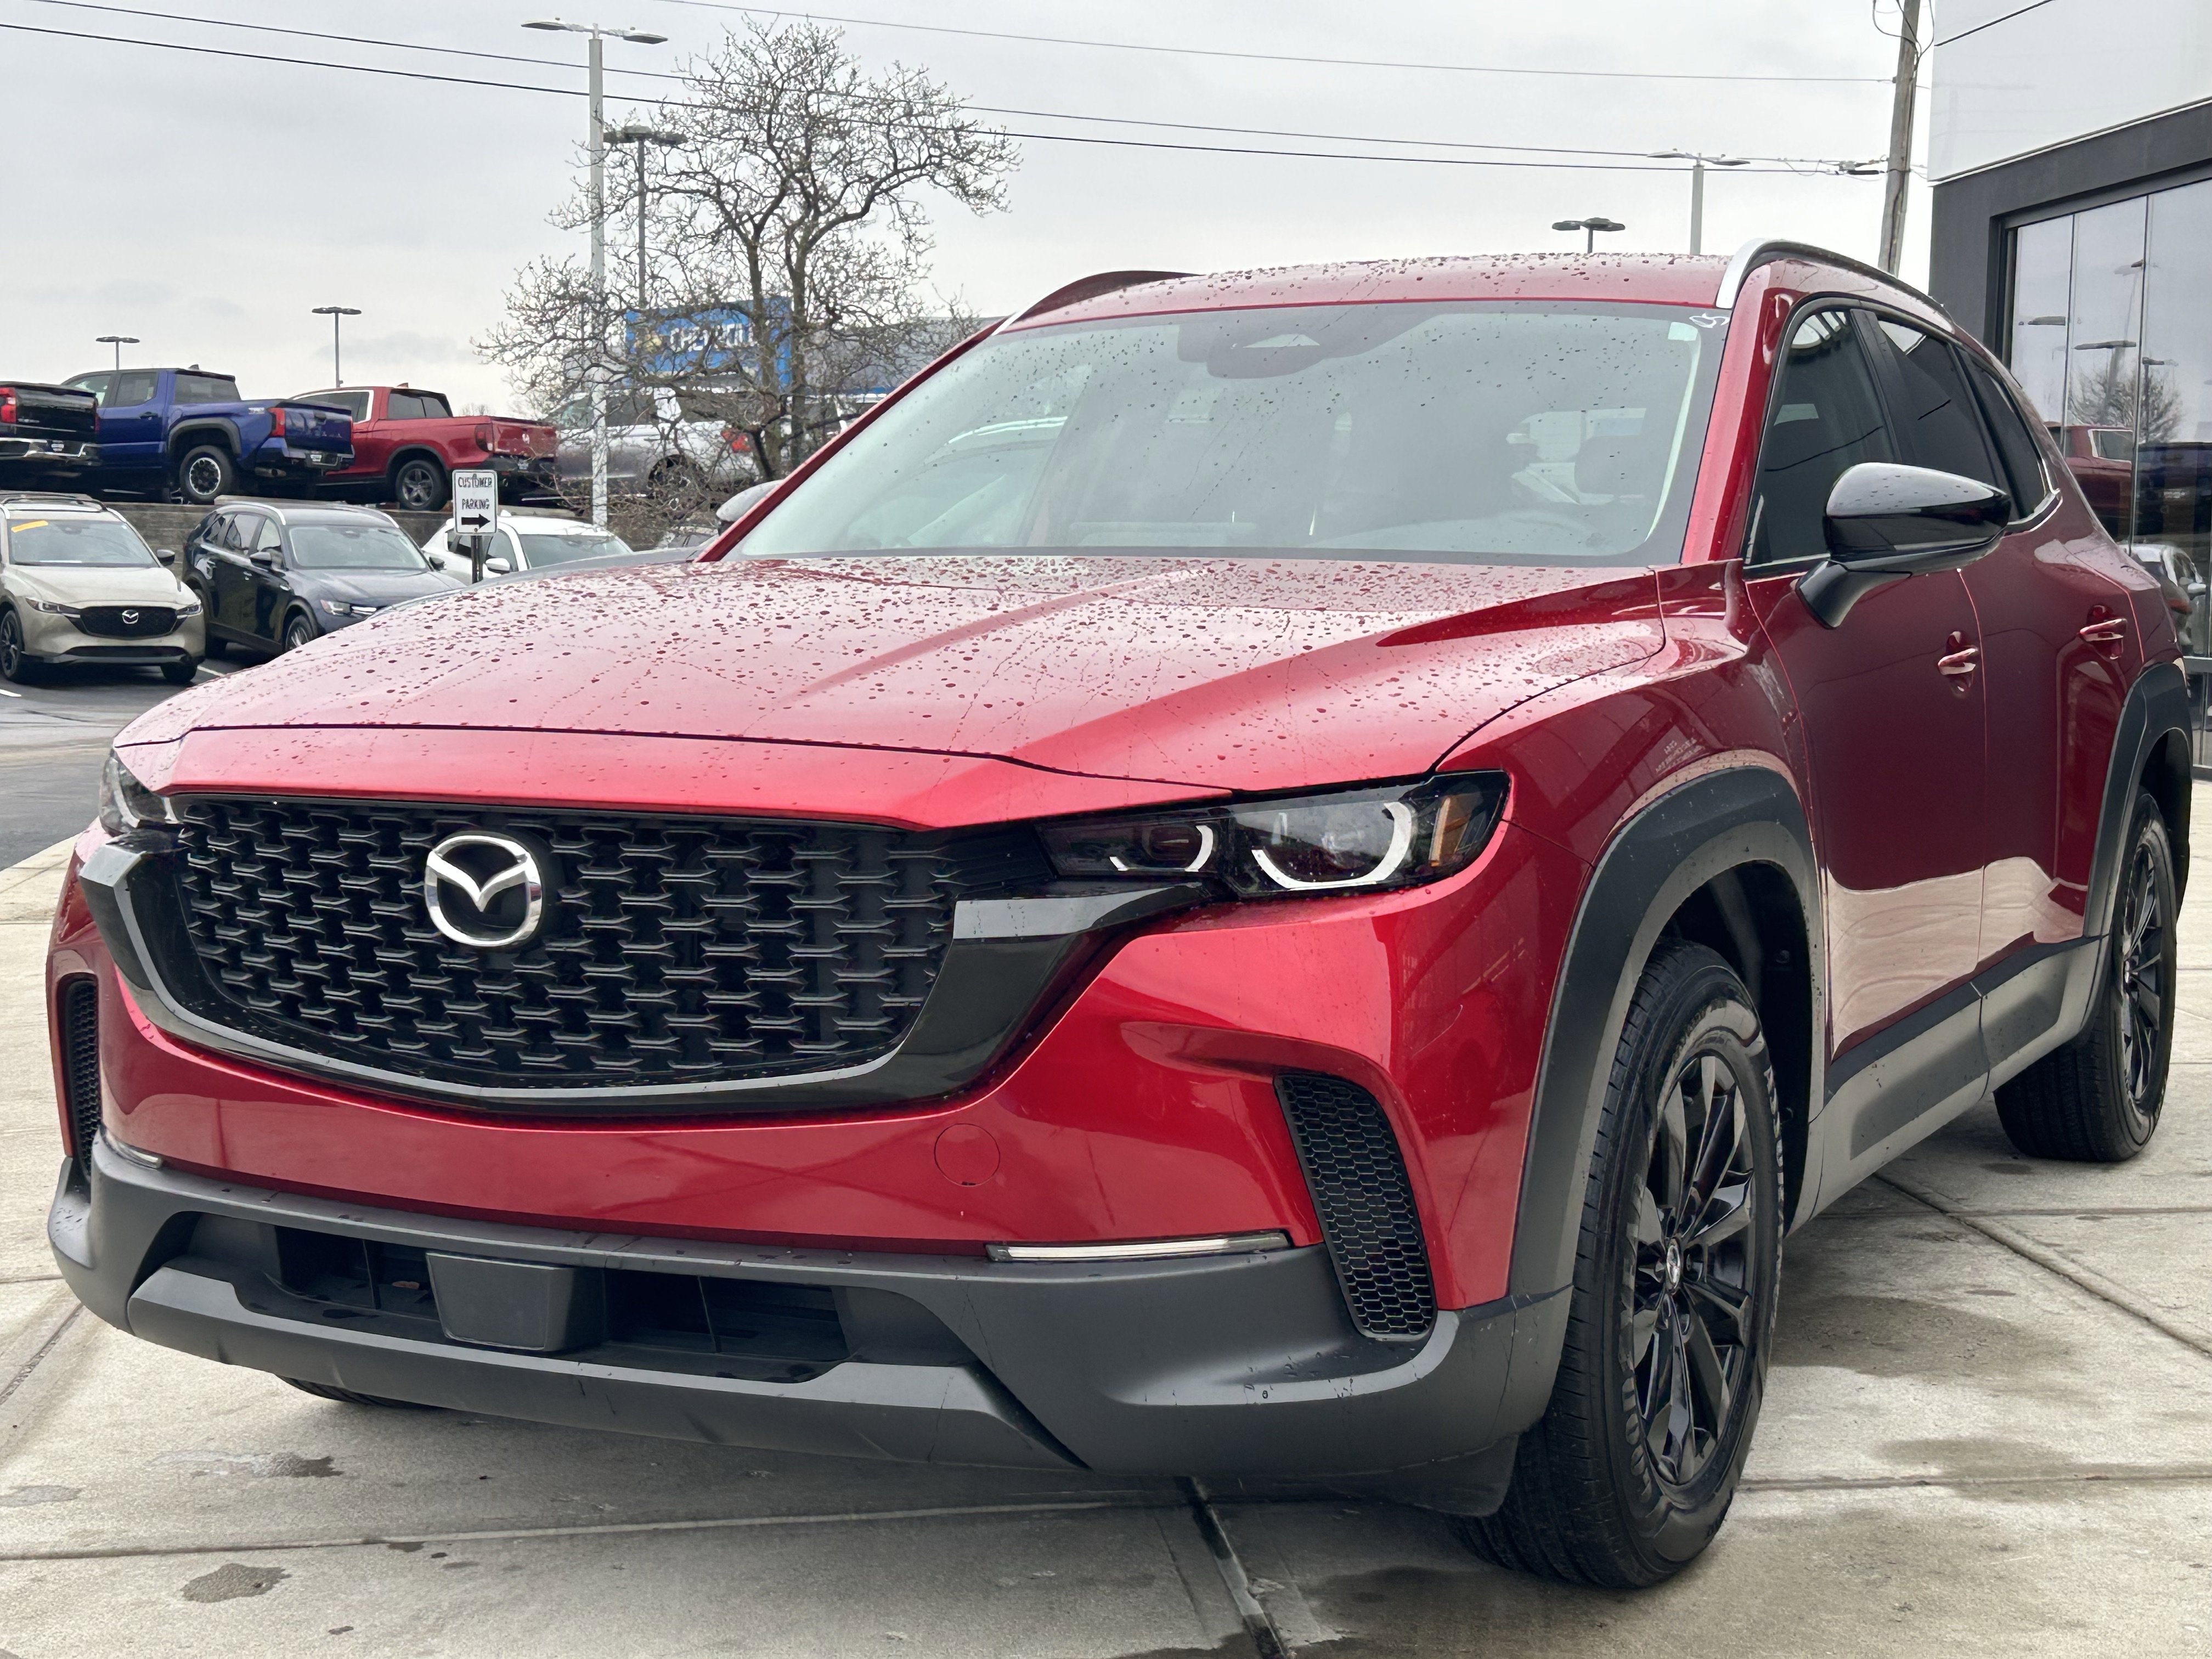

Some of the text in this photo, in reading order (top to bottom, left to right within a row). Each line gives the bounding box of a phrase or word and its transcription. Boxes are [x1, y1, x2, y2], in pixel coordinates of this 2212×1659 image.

[669, 320, 774, 352] CHEVOL
[458, 476, 493, 488] CUSTOMER
[461, 498, 490, 510] PARKING
